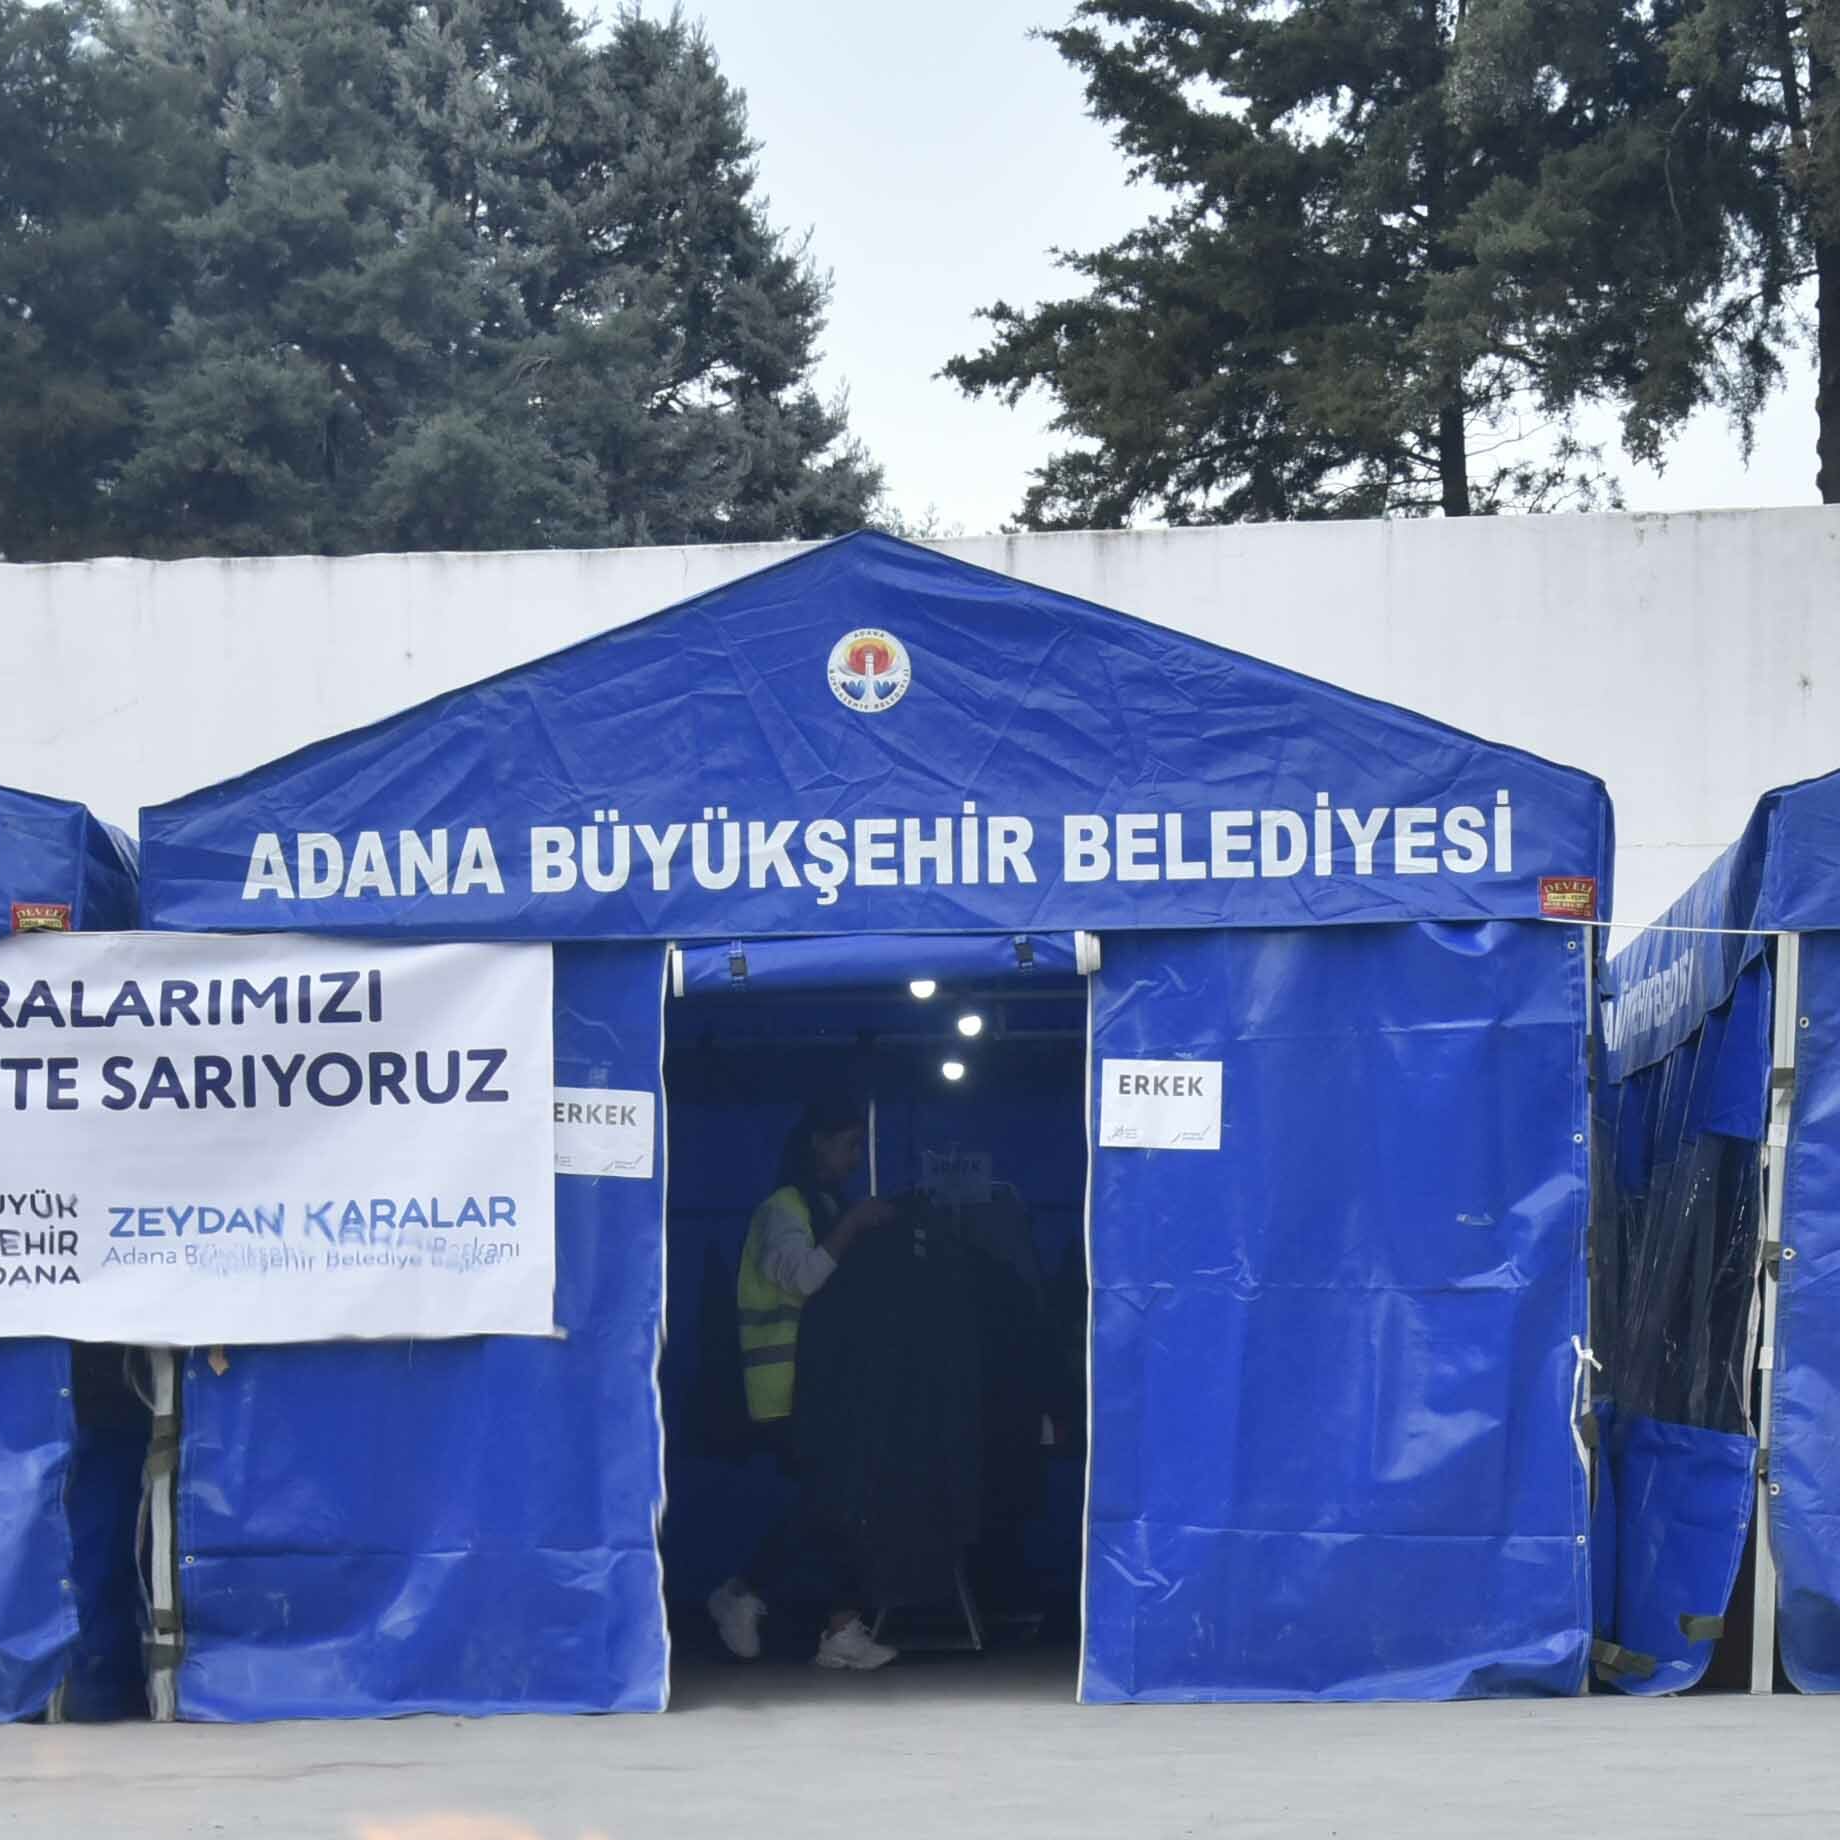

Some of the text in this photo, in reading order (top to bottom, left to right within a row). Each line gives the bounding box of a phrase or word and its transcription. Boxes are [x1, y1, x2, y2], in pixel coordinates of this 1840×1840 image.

[241, 789, 1512, 905] ADANA BÜYÜKŞEHİR BELEDİYESİ
[101, 1047, 510, 1111] SARIYORUZ
[1118, 1074, 1204, 1097] ERKEK
[553, 1102, 638, 1127] ERKEK
[107, 1195, 518, 1241] ZEYDAN KARALAR
[101, 1247, 177, 1267] Adana
